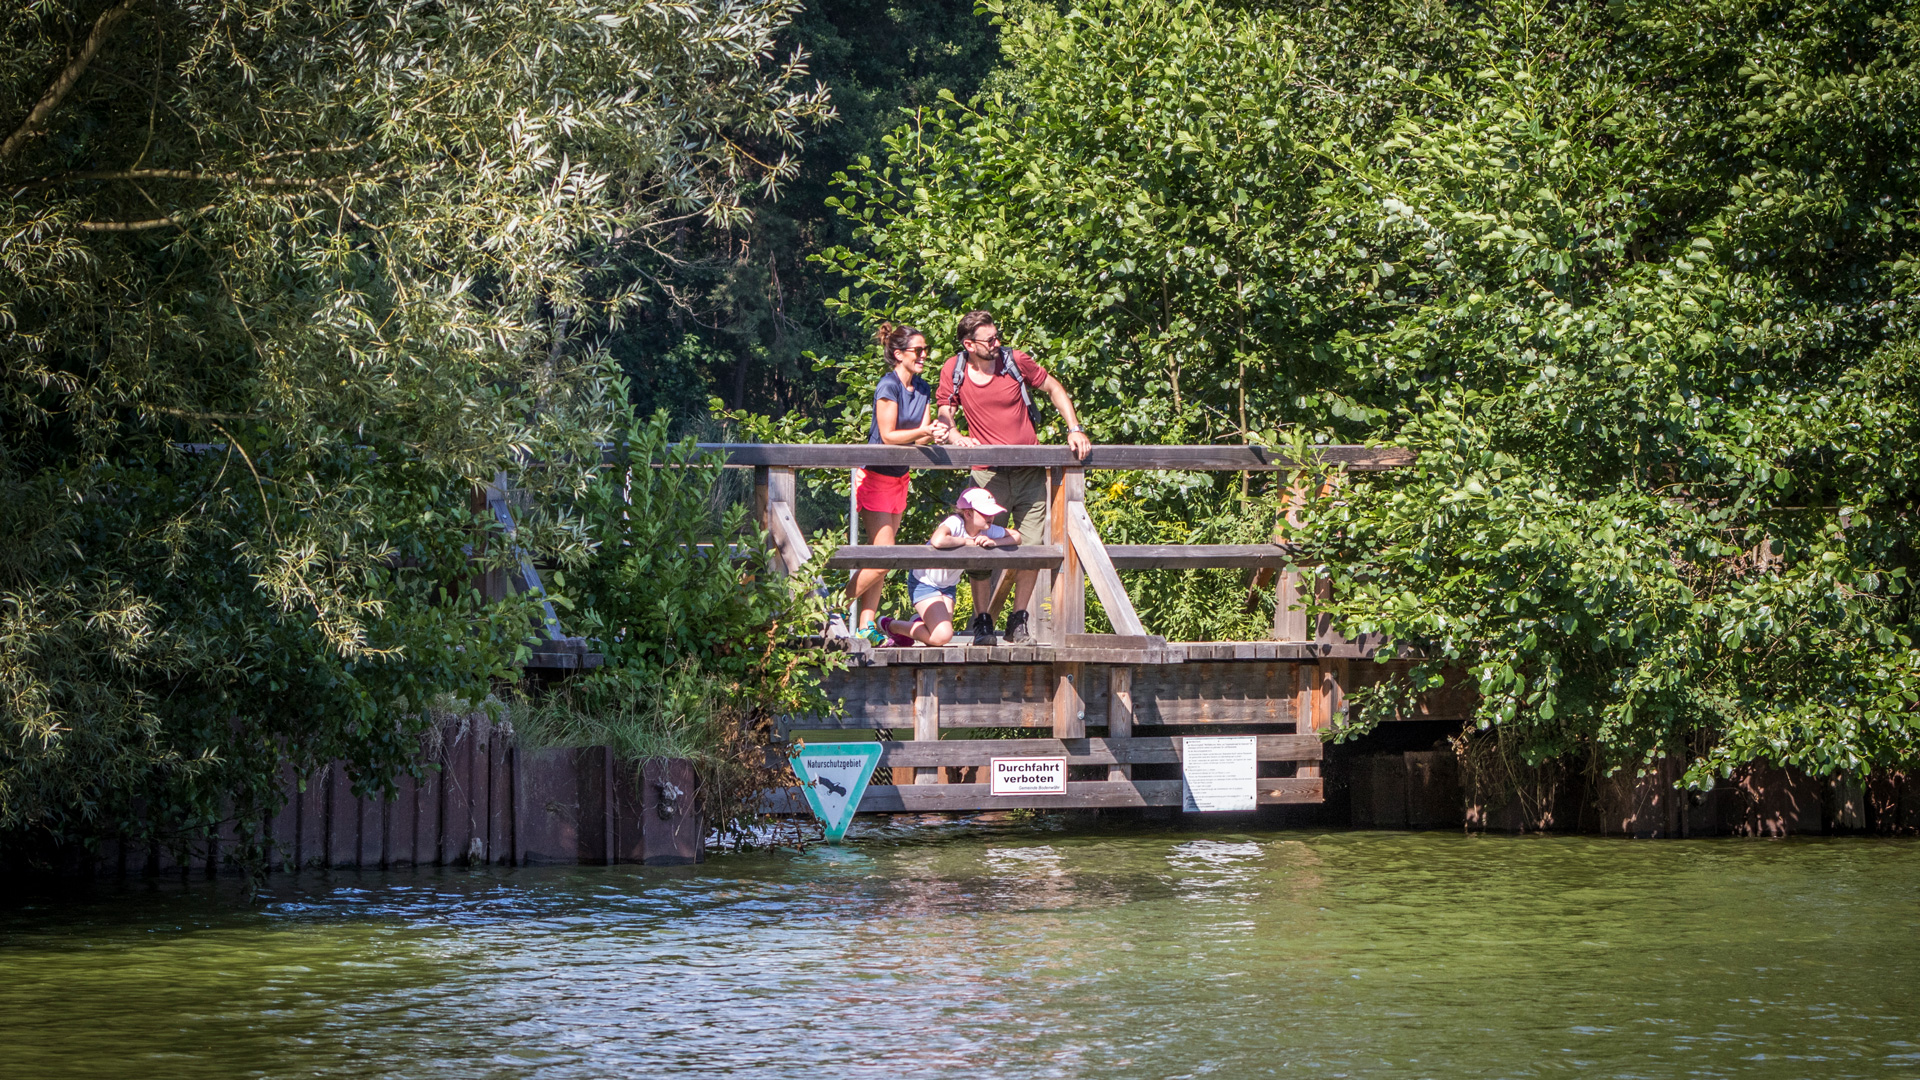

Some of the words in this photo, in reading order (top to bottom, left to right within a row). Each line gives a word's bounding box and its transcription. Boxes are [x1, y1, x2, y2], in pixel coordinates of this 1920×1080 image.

[807, 758, 862, 770] Naturschutzgebiet
[998, 763, 1060, 772] Durchfahrt
[1003, 774, 1054, 783] verboten
